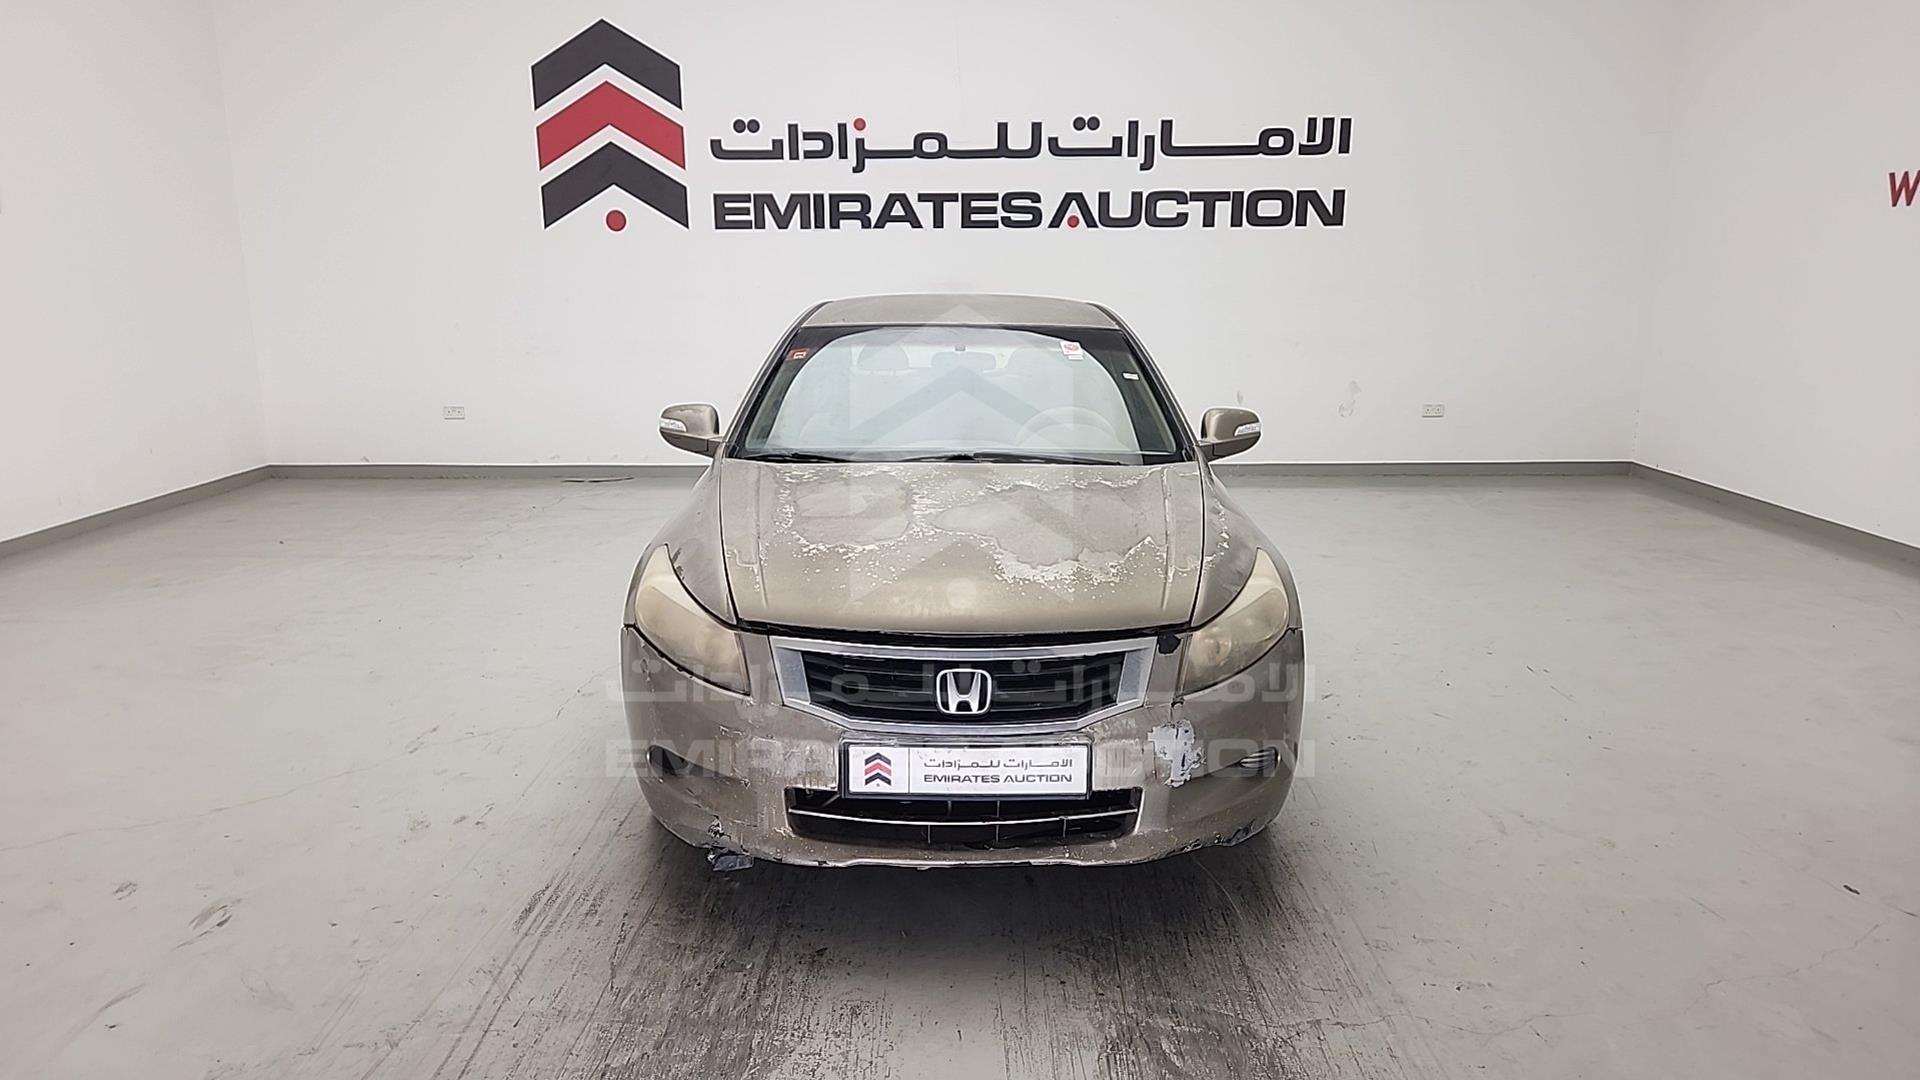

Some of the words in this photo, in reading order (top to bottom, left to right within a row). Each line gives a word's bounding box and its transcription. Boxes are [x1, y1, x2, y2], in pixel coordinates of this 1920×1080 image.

[709, 117, 1042, 174] للمزادات
[1047, 115, 1353, 171] الامارات
[713, 191, 1042, 230] EMIRATES
[1047, 189, 1346, 229] AUCTION
[923, 774, 1000, 784] EMIRATES
[1003, 774, 1073, 784] AUCTION
